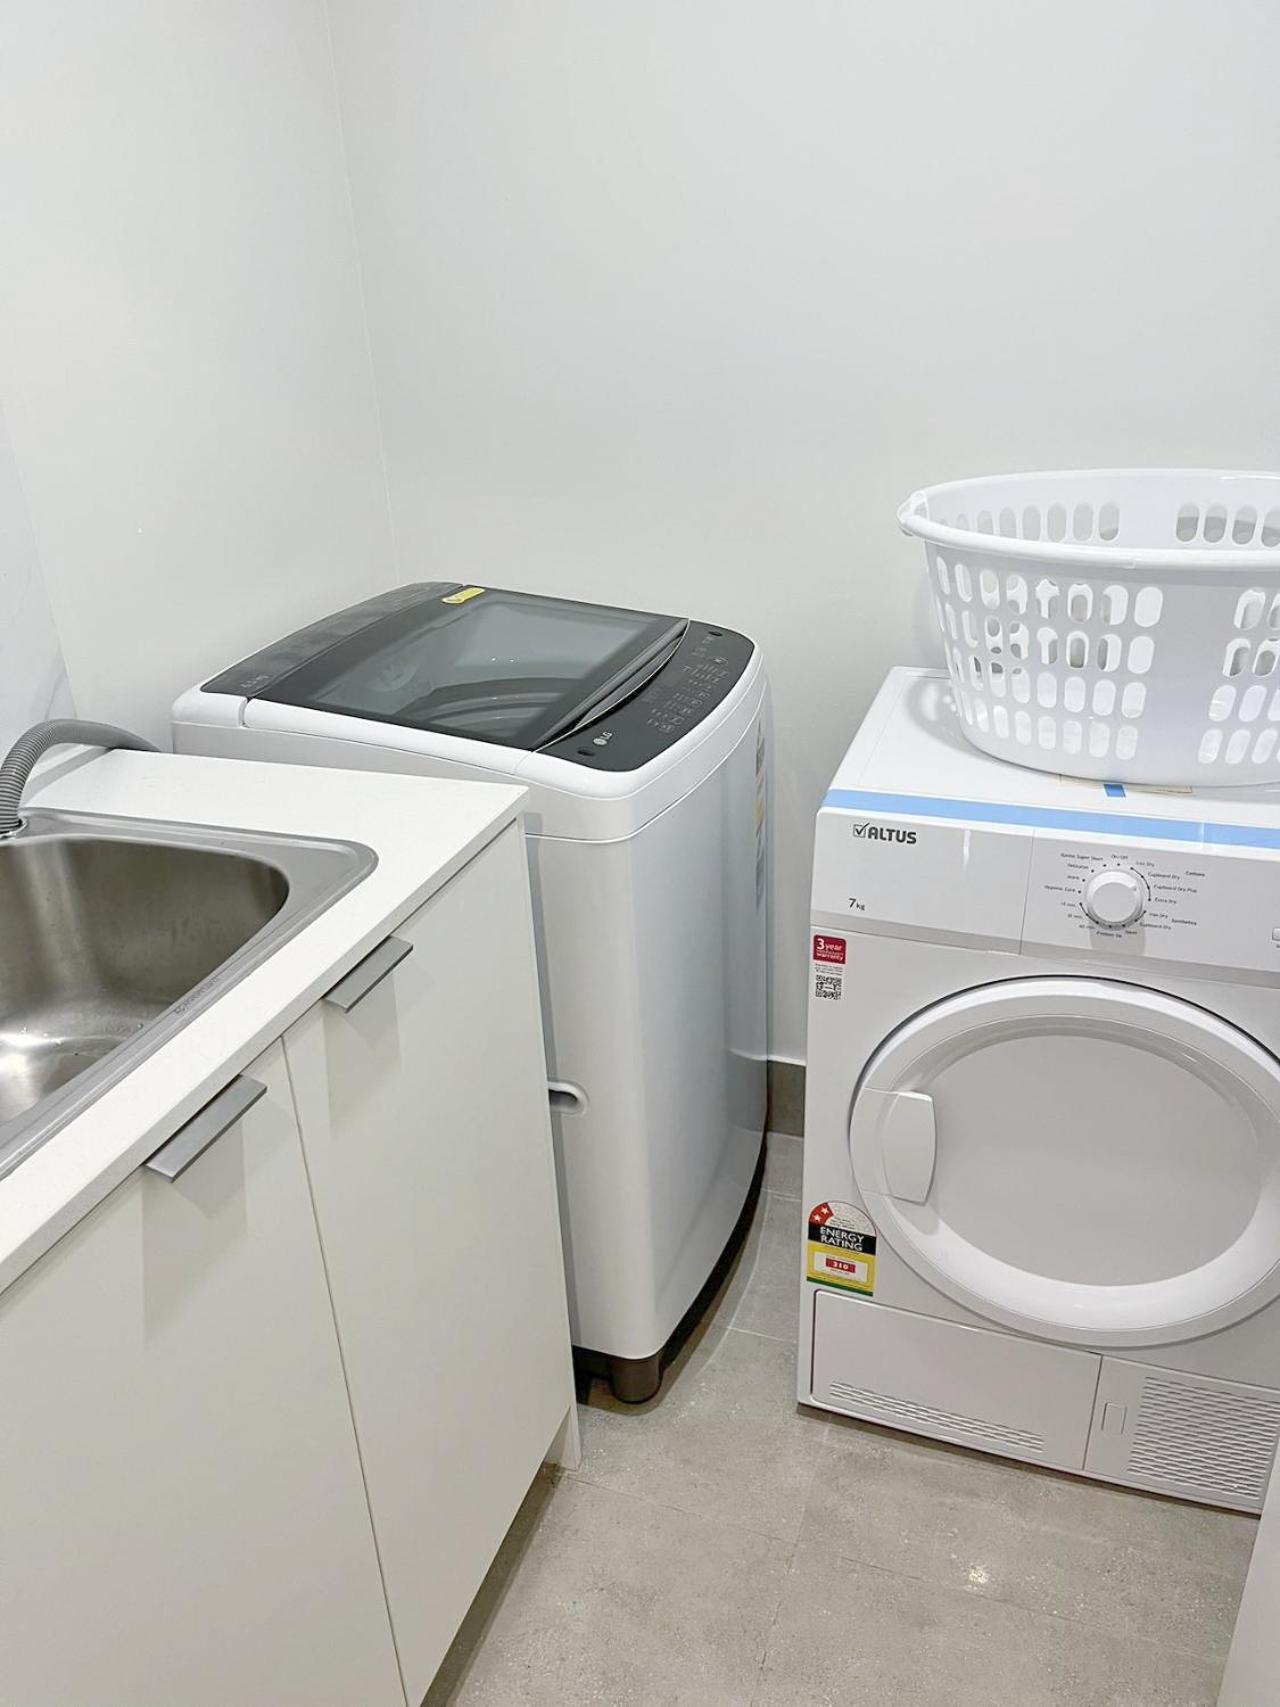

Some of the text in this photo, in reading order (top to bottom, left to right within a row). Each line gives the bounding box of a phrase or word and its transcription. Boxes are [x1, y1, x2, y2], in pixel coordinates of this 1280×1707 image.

[867, 827, 917, 845] ALTUS
[816, 937, 825, 950] 3
[825, 943, 843, 952] year
[820, 1226, 865, 1243] ENERGY
[820, 1235, 863, 1251] RATING
